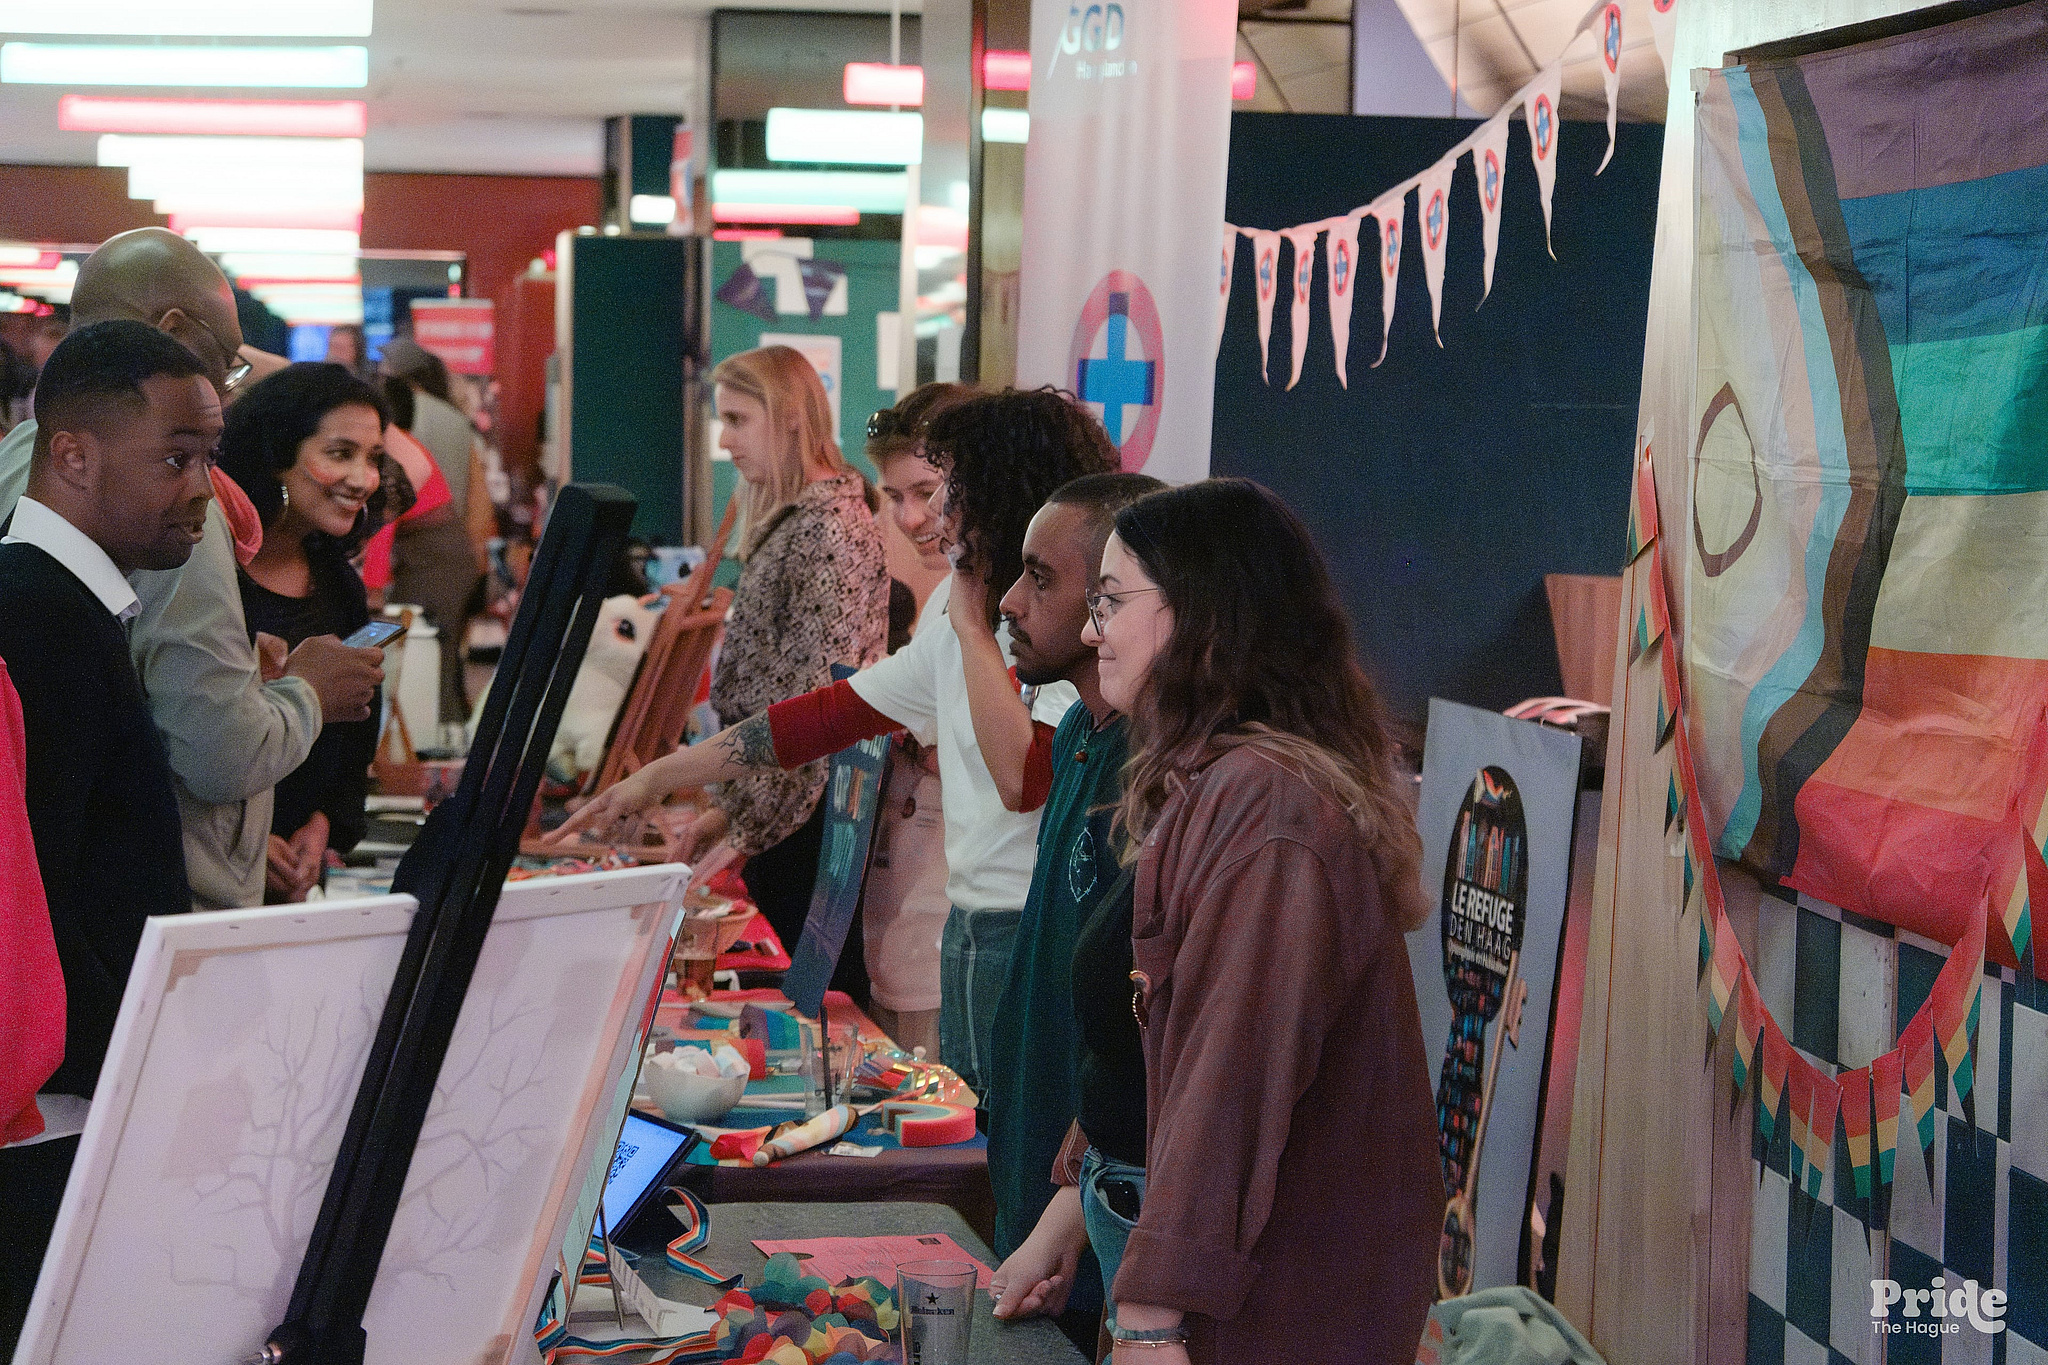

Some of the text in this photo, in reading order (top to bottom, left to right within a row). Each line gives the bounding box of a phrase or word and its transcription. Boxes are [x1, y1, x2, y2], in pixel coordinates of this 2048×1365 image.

[1451, 880, 1515, 935] LE REFUGE
[1449, 913, 1474, 945] DEN
[1477, 925, 1512, 960] HAAG
